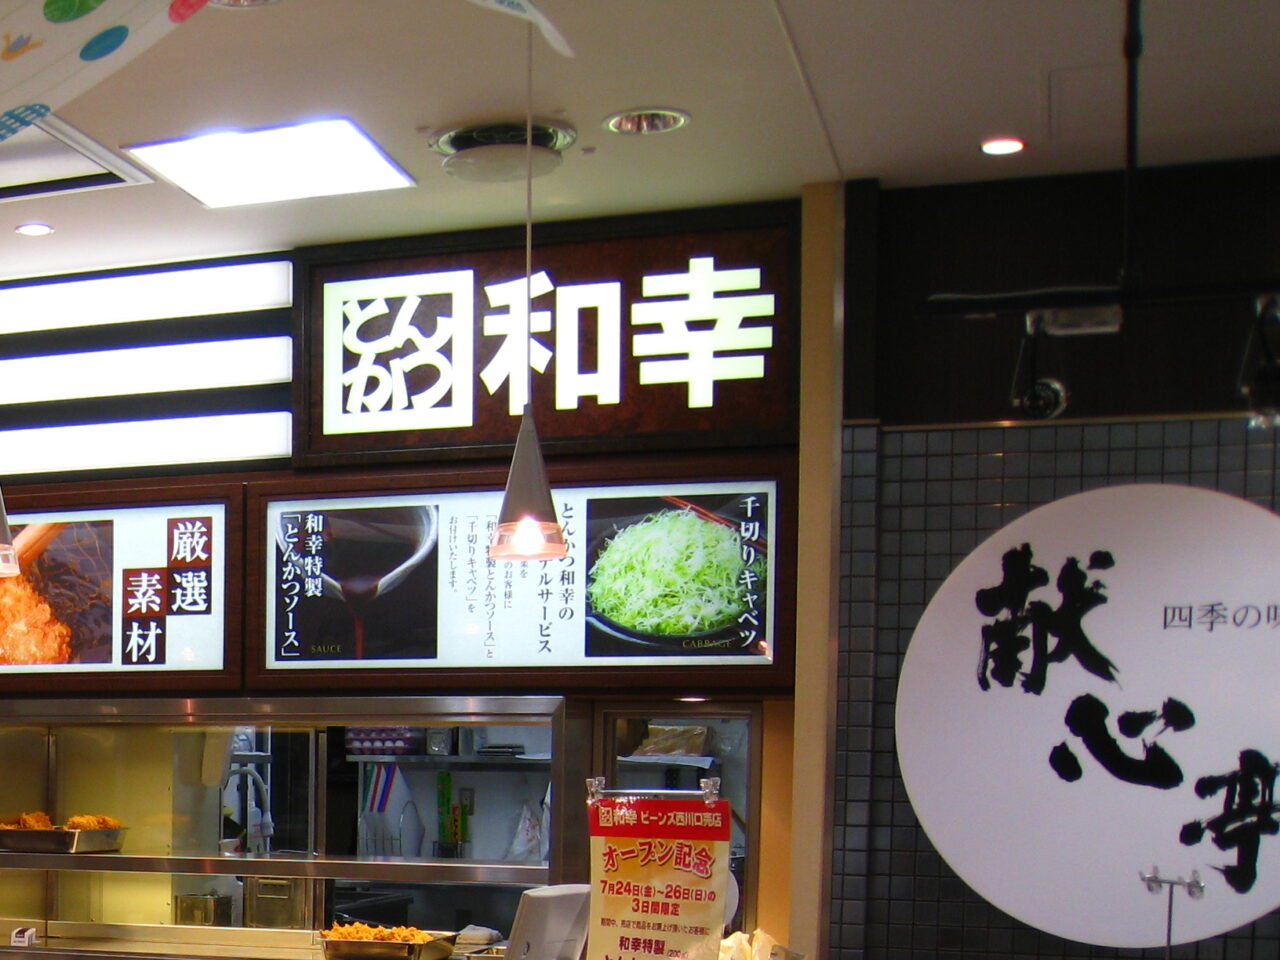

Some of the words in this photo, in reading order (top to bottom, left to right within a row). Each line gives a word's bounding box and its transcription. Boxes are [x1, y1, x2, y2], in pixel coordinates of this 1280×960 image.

[479, 257, 775, 416] 和幸
[171, 521, 209, 612] 厳選
[304, 513, 324, 598] 和幸特製
[738, 496, 760, 648] 千切りキャベツ
[126, 572, 162, 663] 素材
[682, 639, 732, 649] CABBAGE
[311, 645, 342, 653] SAUCE
[602, 841, 714, 880] オープン記念
[632, 898, 681, 917] 3日間限定
[619, 936, 666, 955] 和幸特製
